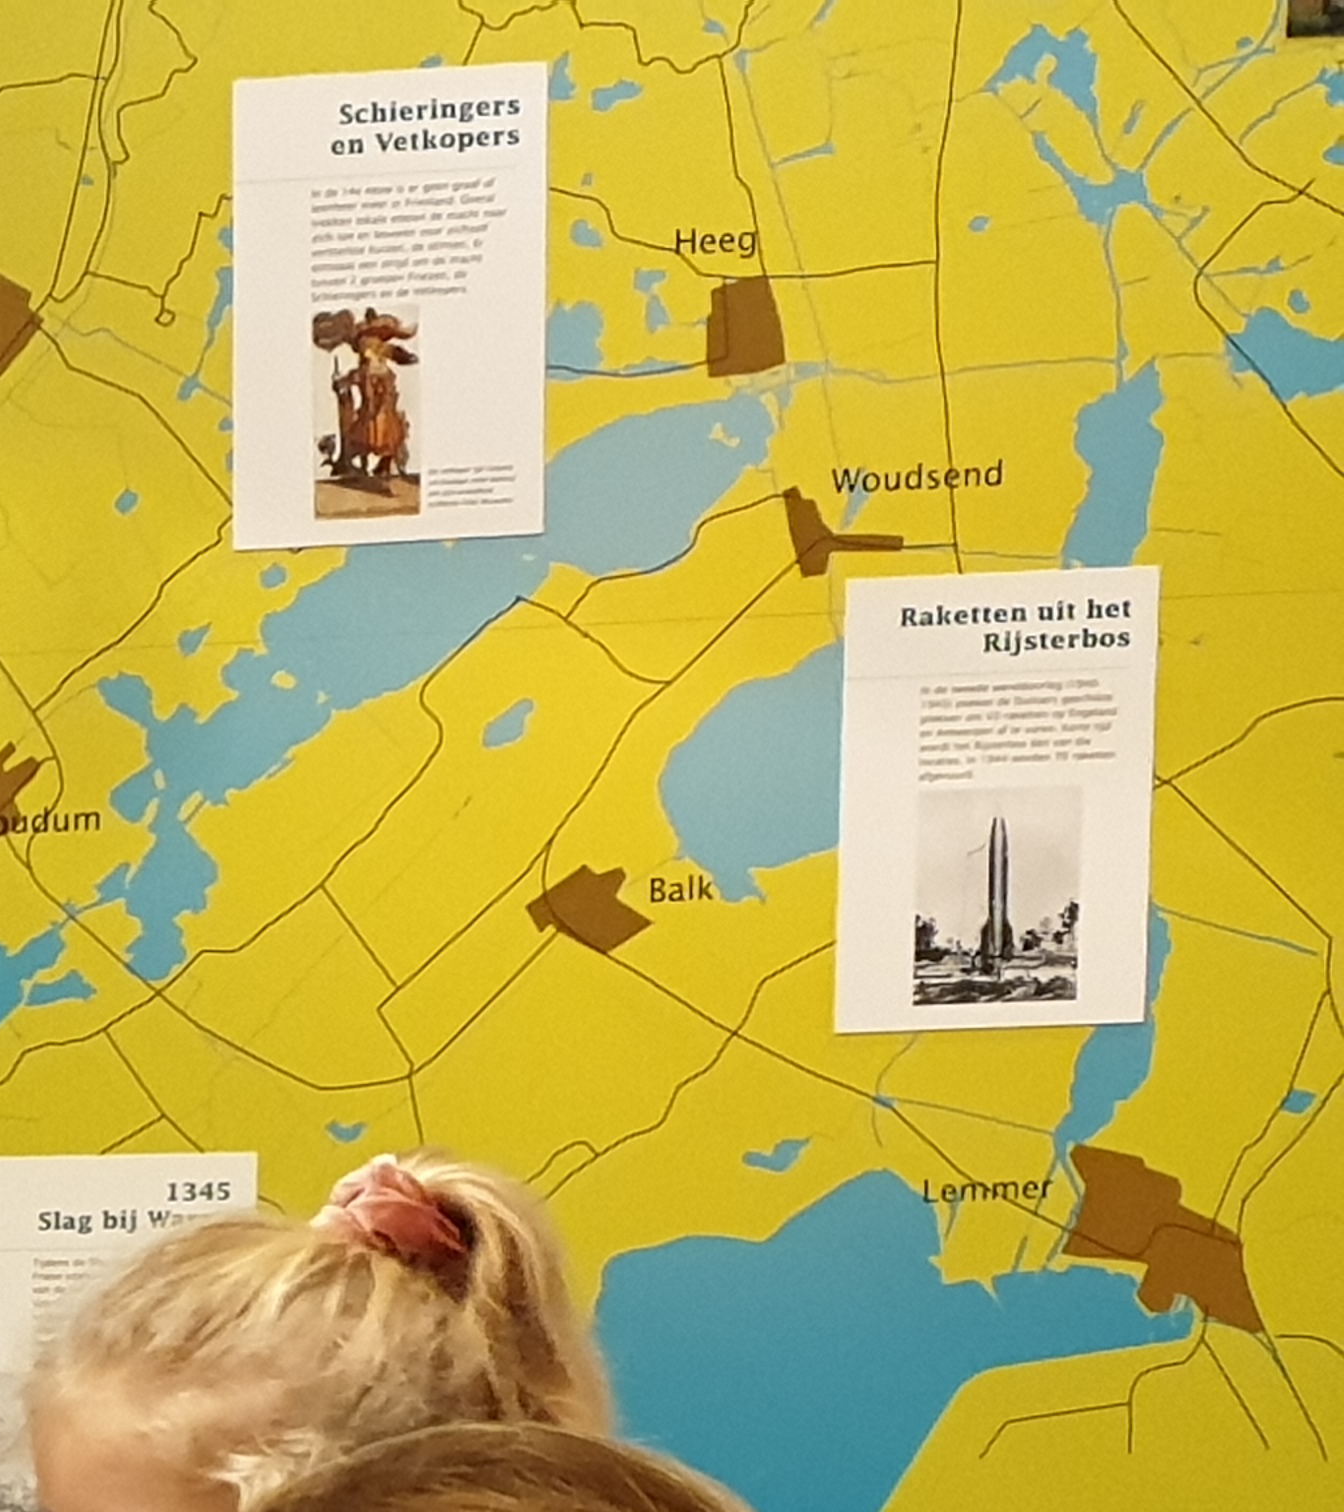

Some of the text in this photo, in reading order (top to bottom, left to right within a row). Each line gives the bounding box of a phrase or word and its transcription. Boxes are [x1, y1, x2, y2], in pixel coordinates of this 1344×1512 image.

[339, 98, 520, 125] Schieringers
[331, 129, 520, 155] en Vetkopers
[675, 228, 755, 258] Heeg
[831, 458, 1004, 494] Woudsend
[900, 599, 1131, 627] Raketten uit het
[983, 628, 1131, 656] Rijsterbos
[650, 874, 713, 903] Balk
[166, 1181, 232, 1202] 1345
[923, 1178, 1053, 1203] Lemmer
[37, 1211, 93, 1234] Slag
[102, 1210, 138, 1233] bij
